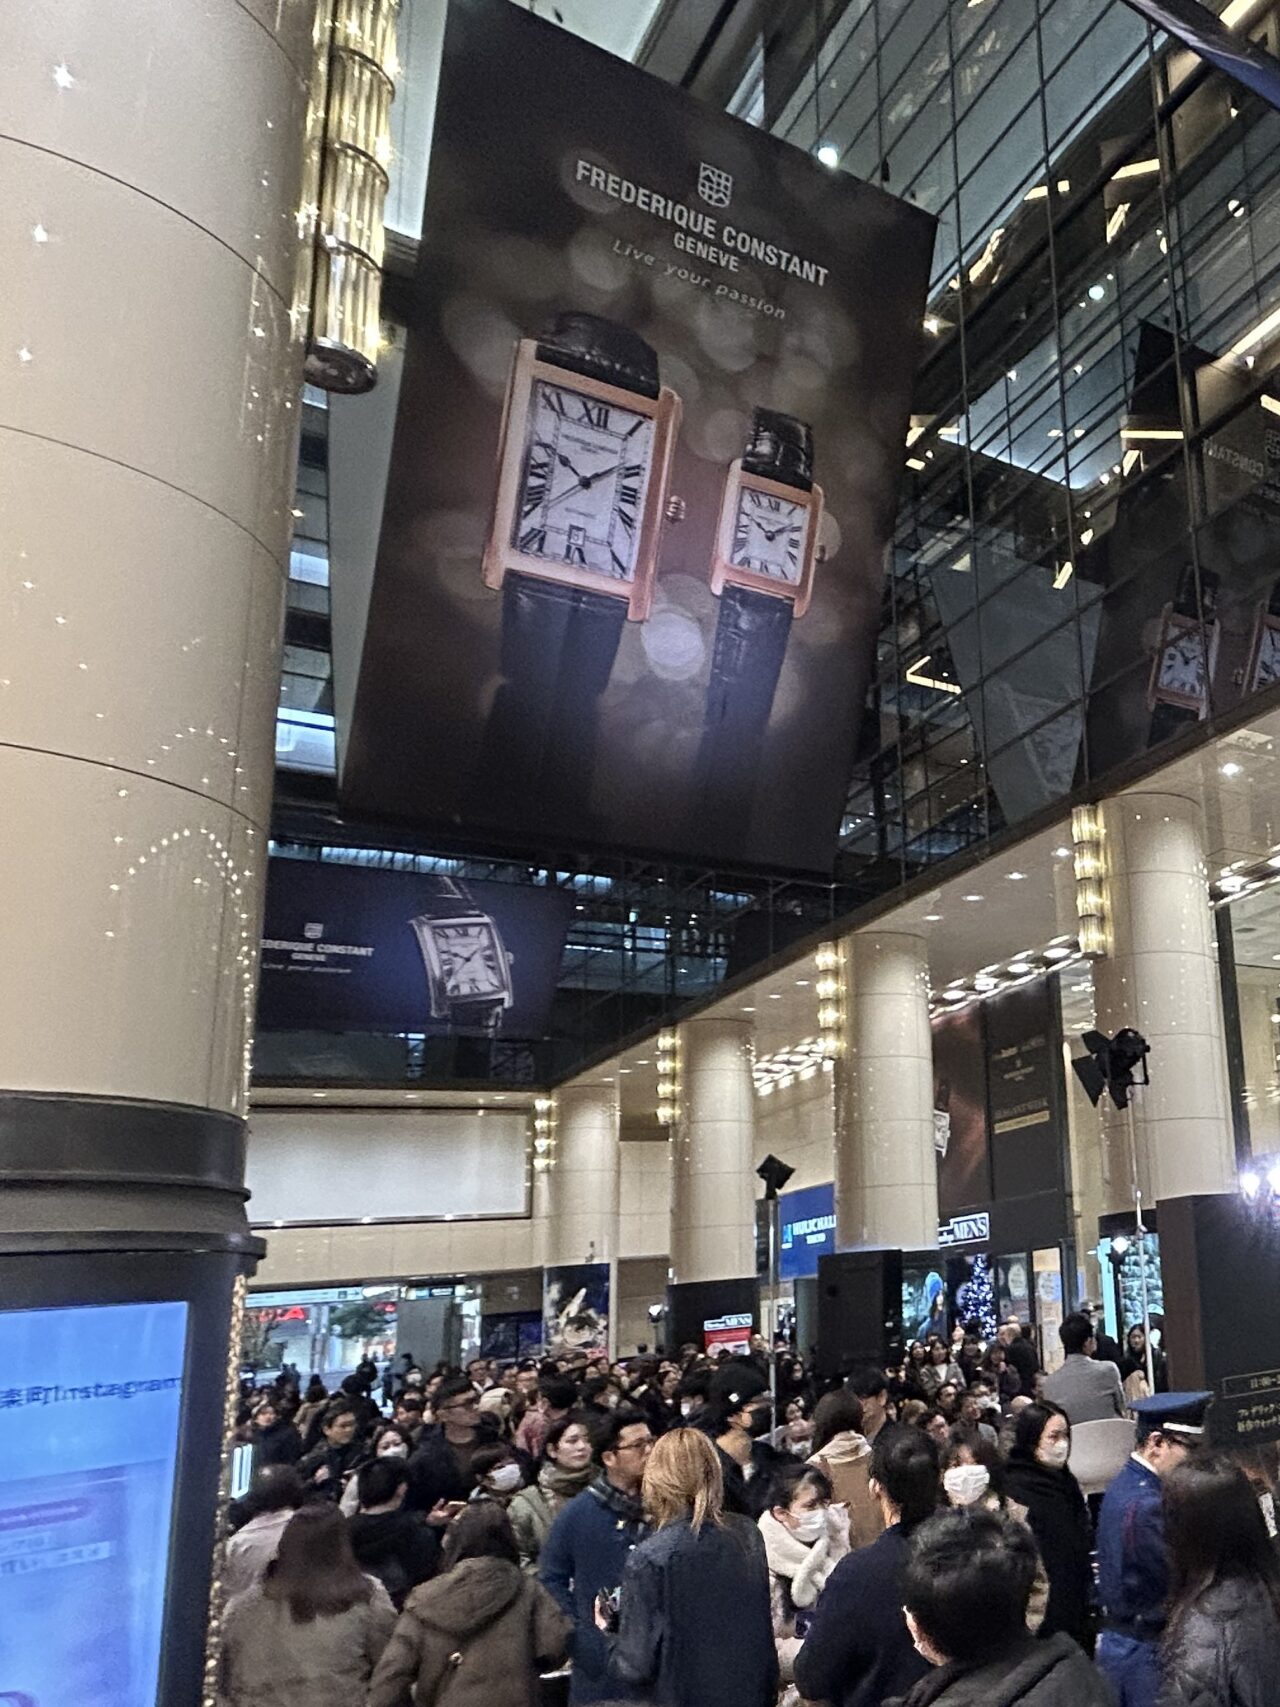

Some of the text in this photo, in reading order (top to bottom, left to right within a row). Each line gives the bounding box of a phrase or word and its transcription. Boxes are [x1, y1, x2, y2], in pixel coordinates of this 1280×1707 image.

[576, 159, 829, 287] FREDERIQUE CONSTANT
[673, 232, 740, 272] GENEVE
[612, 240, 787, 320] Live your passion
